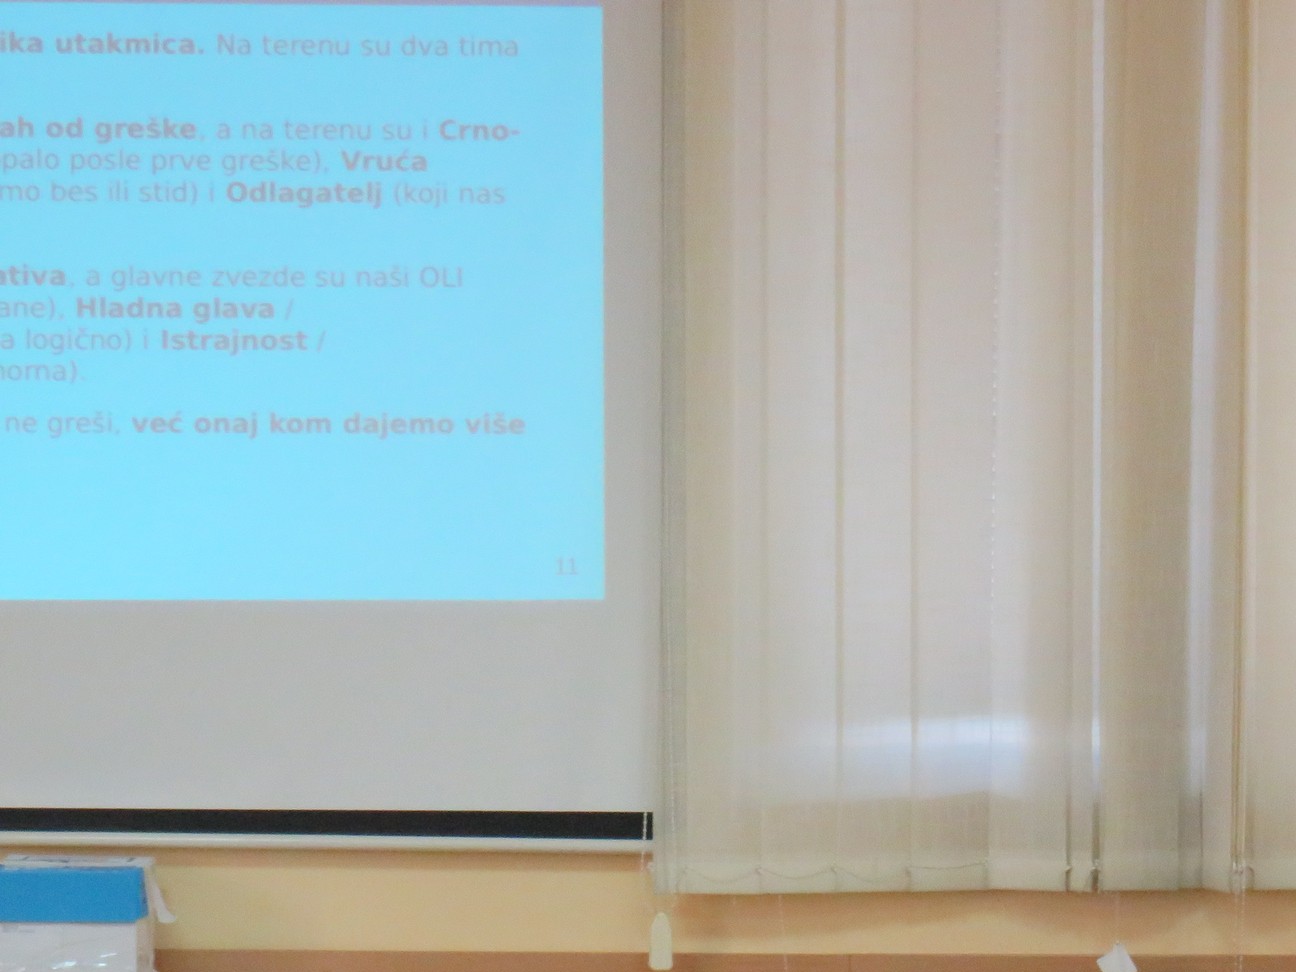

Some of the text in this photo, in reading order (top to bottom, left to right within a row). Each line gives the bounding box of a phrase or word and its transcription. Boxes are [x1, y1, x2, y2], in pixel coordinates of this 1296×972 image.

[55, 32, 204, 55] utakmica.
[216, 33, 252, 55] Na
[261, 35, 351, 57] terenu
[360, 39, 392, 58] su
[400, 35, 449, 57] dva
[458, 37, 520, 58] tima
[46, 116, 84, 138] od
[215, 122, 232, 140] a
[241, 122, 274, 140] na
[283, 120, 372, 140] terenu
[381, 123, 413, 141] su
[438, 118, 521, 141] Crno-
[70, 150, 140, 173] posle
[152, 154, 212, 175] prve
[341, 150, 428, 172] Vruća
[50, 182, 98, 203] bes
[108, 180, 129, 202] ili
[139, 182, 199, 205] stid)
[226, 181, 382, 209] Odlagatelj
[393, 182, 449, 209] (koji
[459, 186, 507, 205] nas
[86, 269, 101, 286] a
[111, 265, 201, 291] glavne
[211, 265, 306, 288] zvezde
[315, 270, 347, 288] su
[355, 265, 410, 288] naši
[418, 265, 464, 289] OLI
[76, 297, 182, 318] Hladna
[193, 297, 275, 323] glava
[26, 327, 132, 355] logično)
[161, 330, 309, 356] Istrajnost
[4, 410, 526, 440] ne greši, već onaj kom dajemo više
[556, 556, 579, 576] 11
